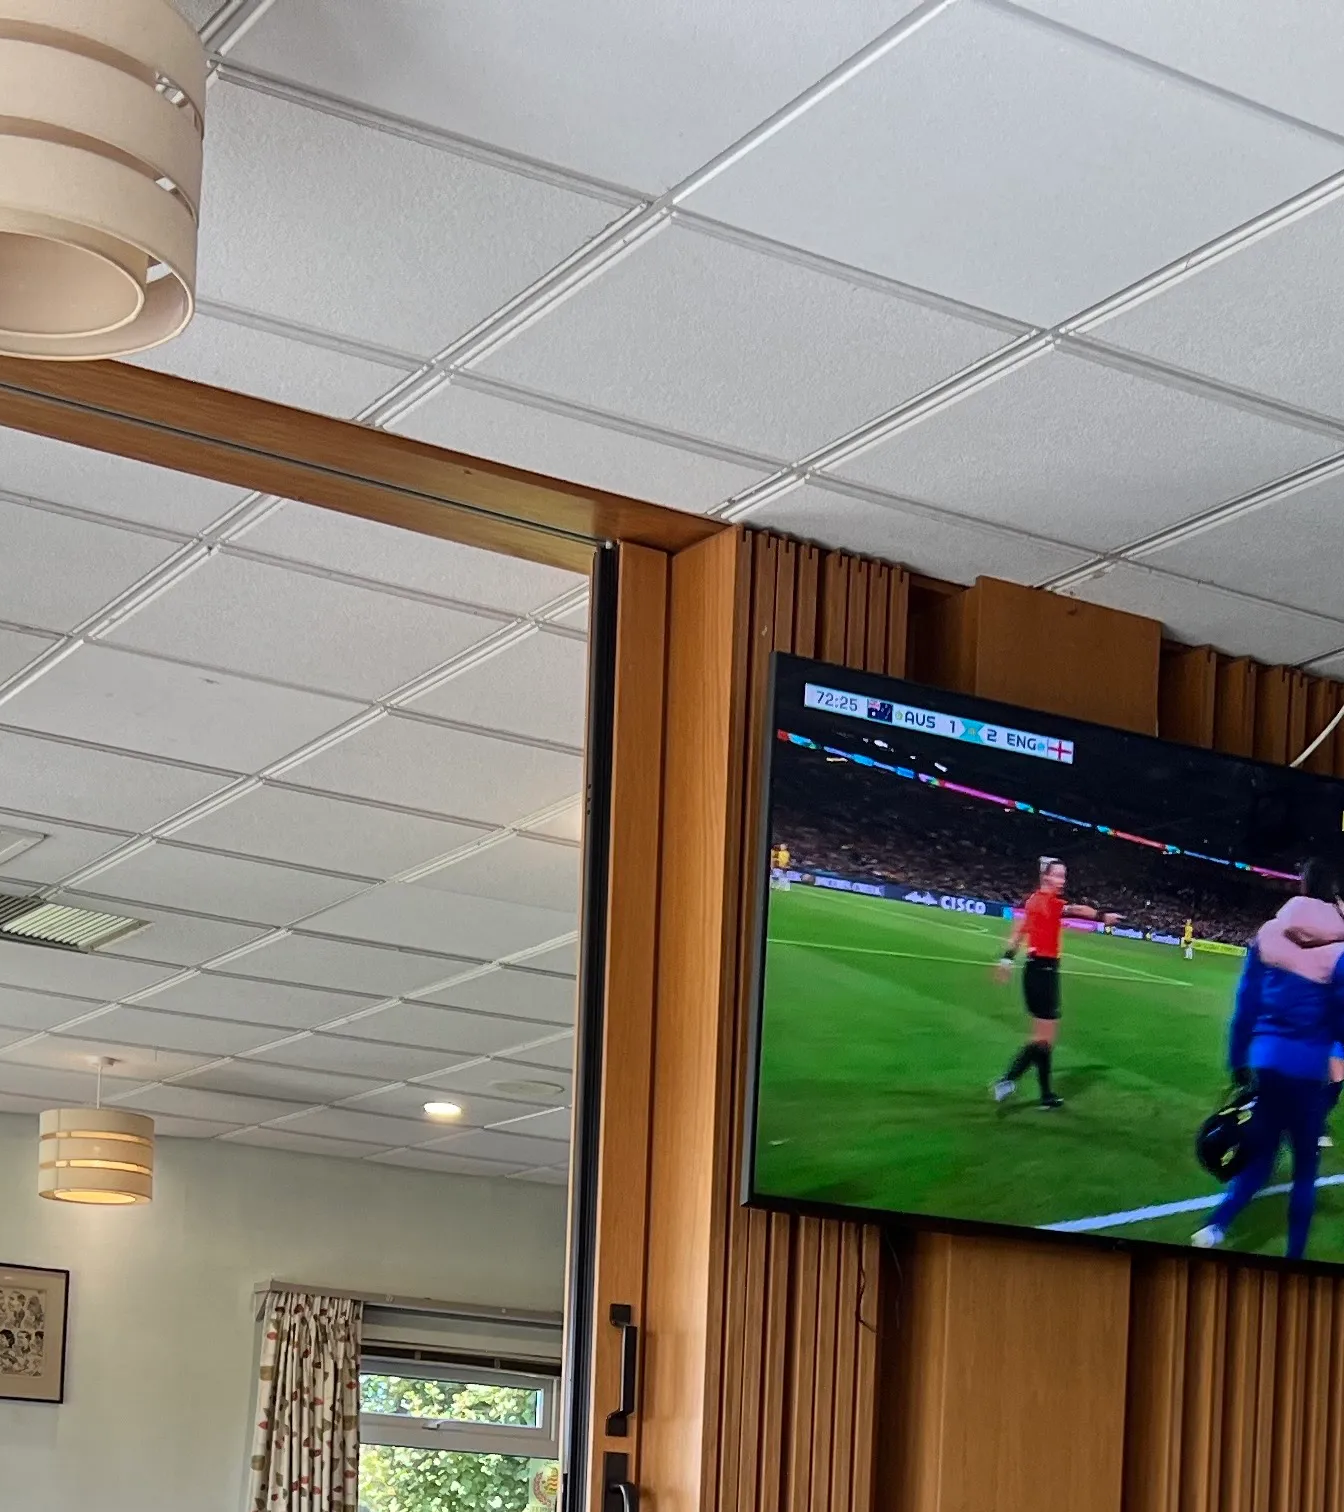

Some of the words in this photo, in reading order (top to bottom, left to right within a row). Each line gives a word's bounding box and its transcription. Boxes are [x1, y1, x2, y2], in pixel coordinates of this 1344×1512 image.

[816, 690, 858, 712] 72:25
[904, 711, 936, 729] AUS
[950, 720, 956, 734] 1
[987, 728, 997, 742] 2
[1006, 733, 1037, 751] ENG
[940, 895, 987, 915] CISCO
